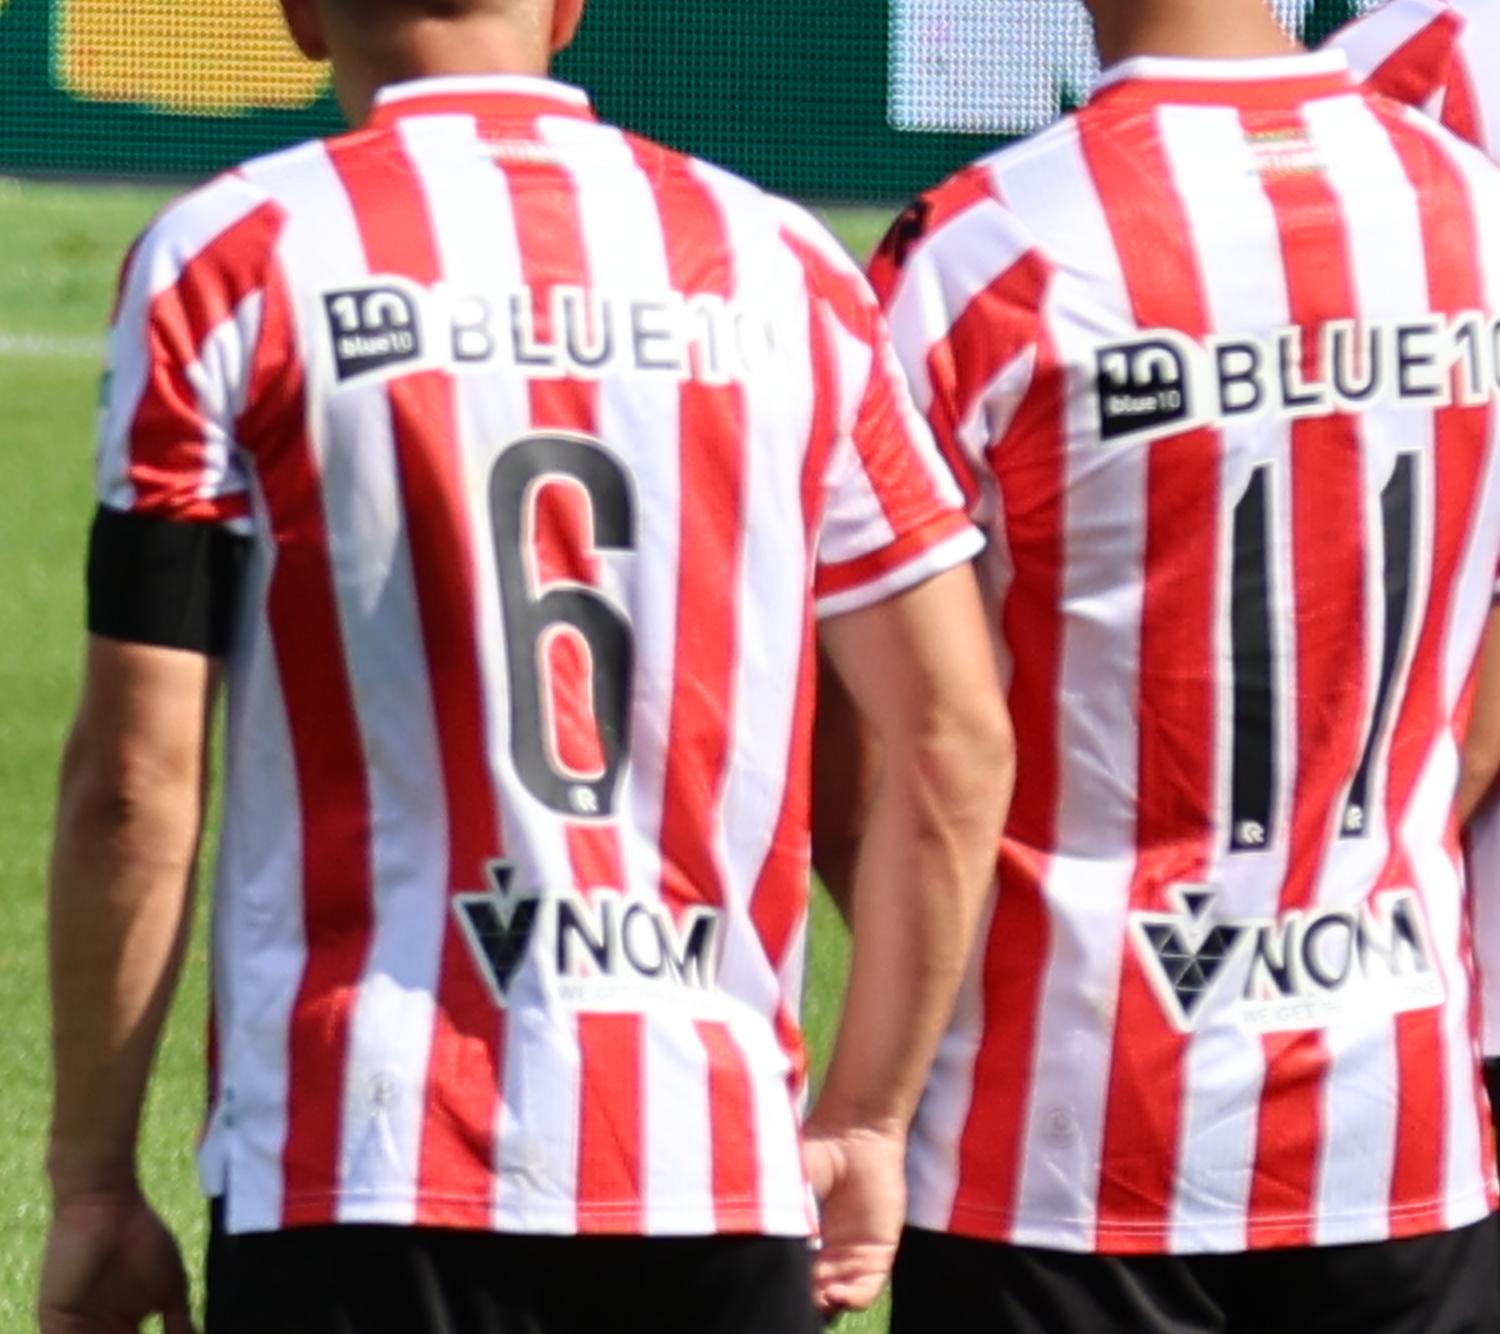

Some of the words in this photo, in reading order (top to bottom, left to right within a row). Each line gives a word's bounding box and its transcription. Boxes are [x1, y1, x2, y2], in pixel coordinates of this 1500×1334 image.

[450, 293, 777, 373] BLUE10
[488, 435, 638, 816] 6
[1231, 453, 1421, 853] 11
